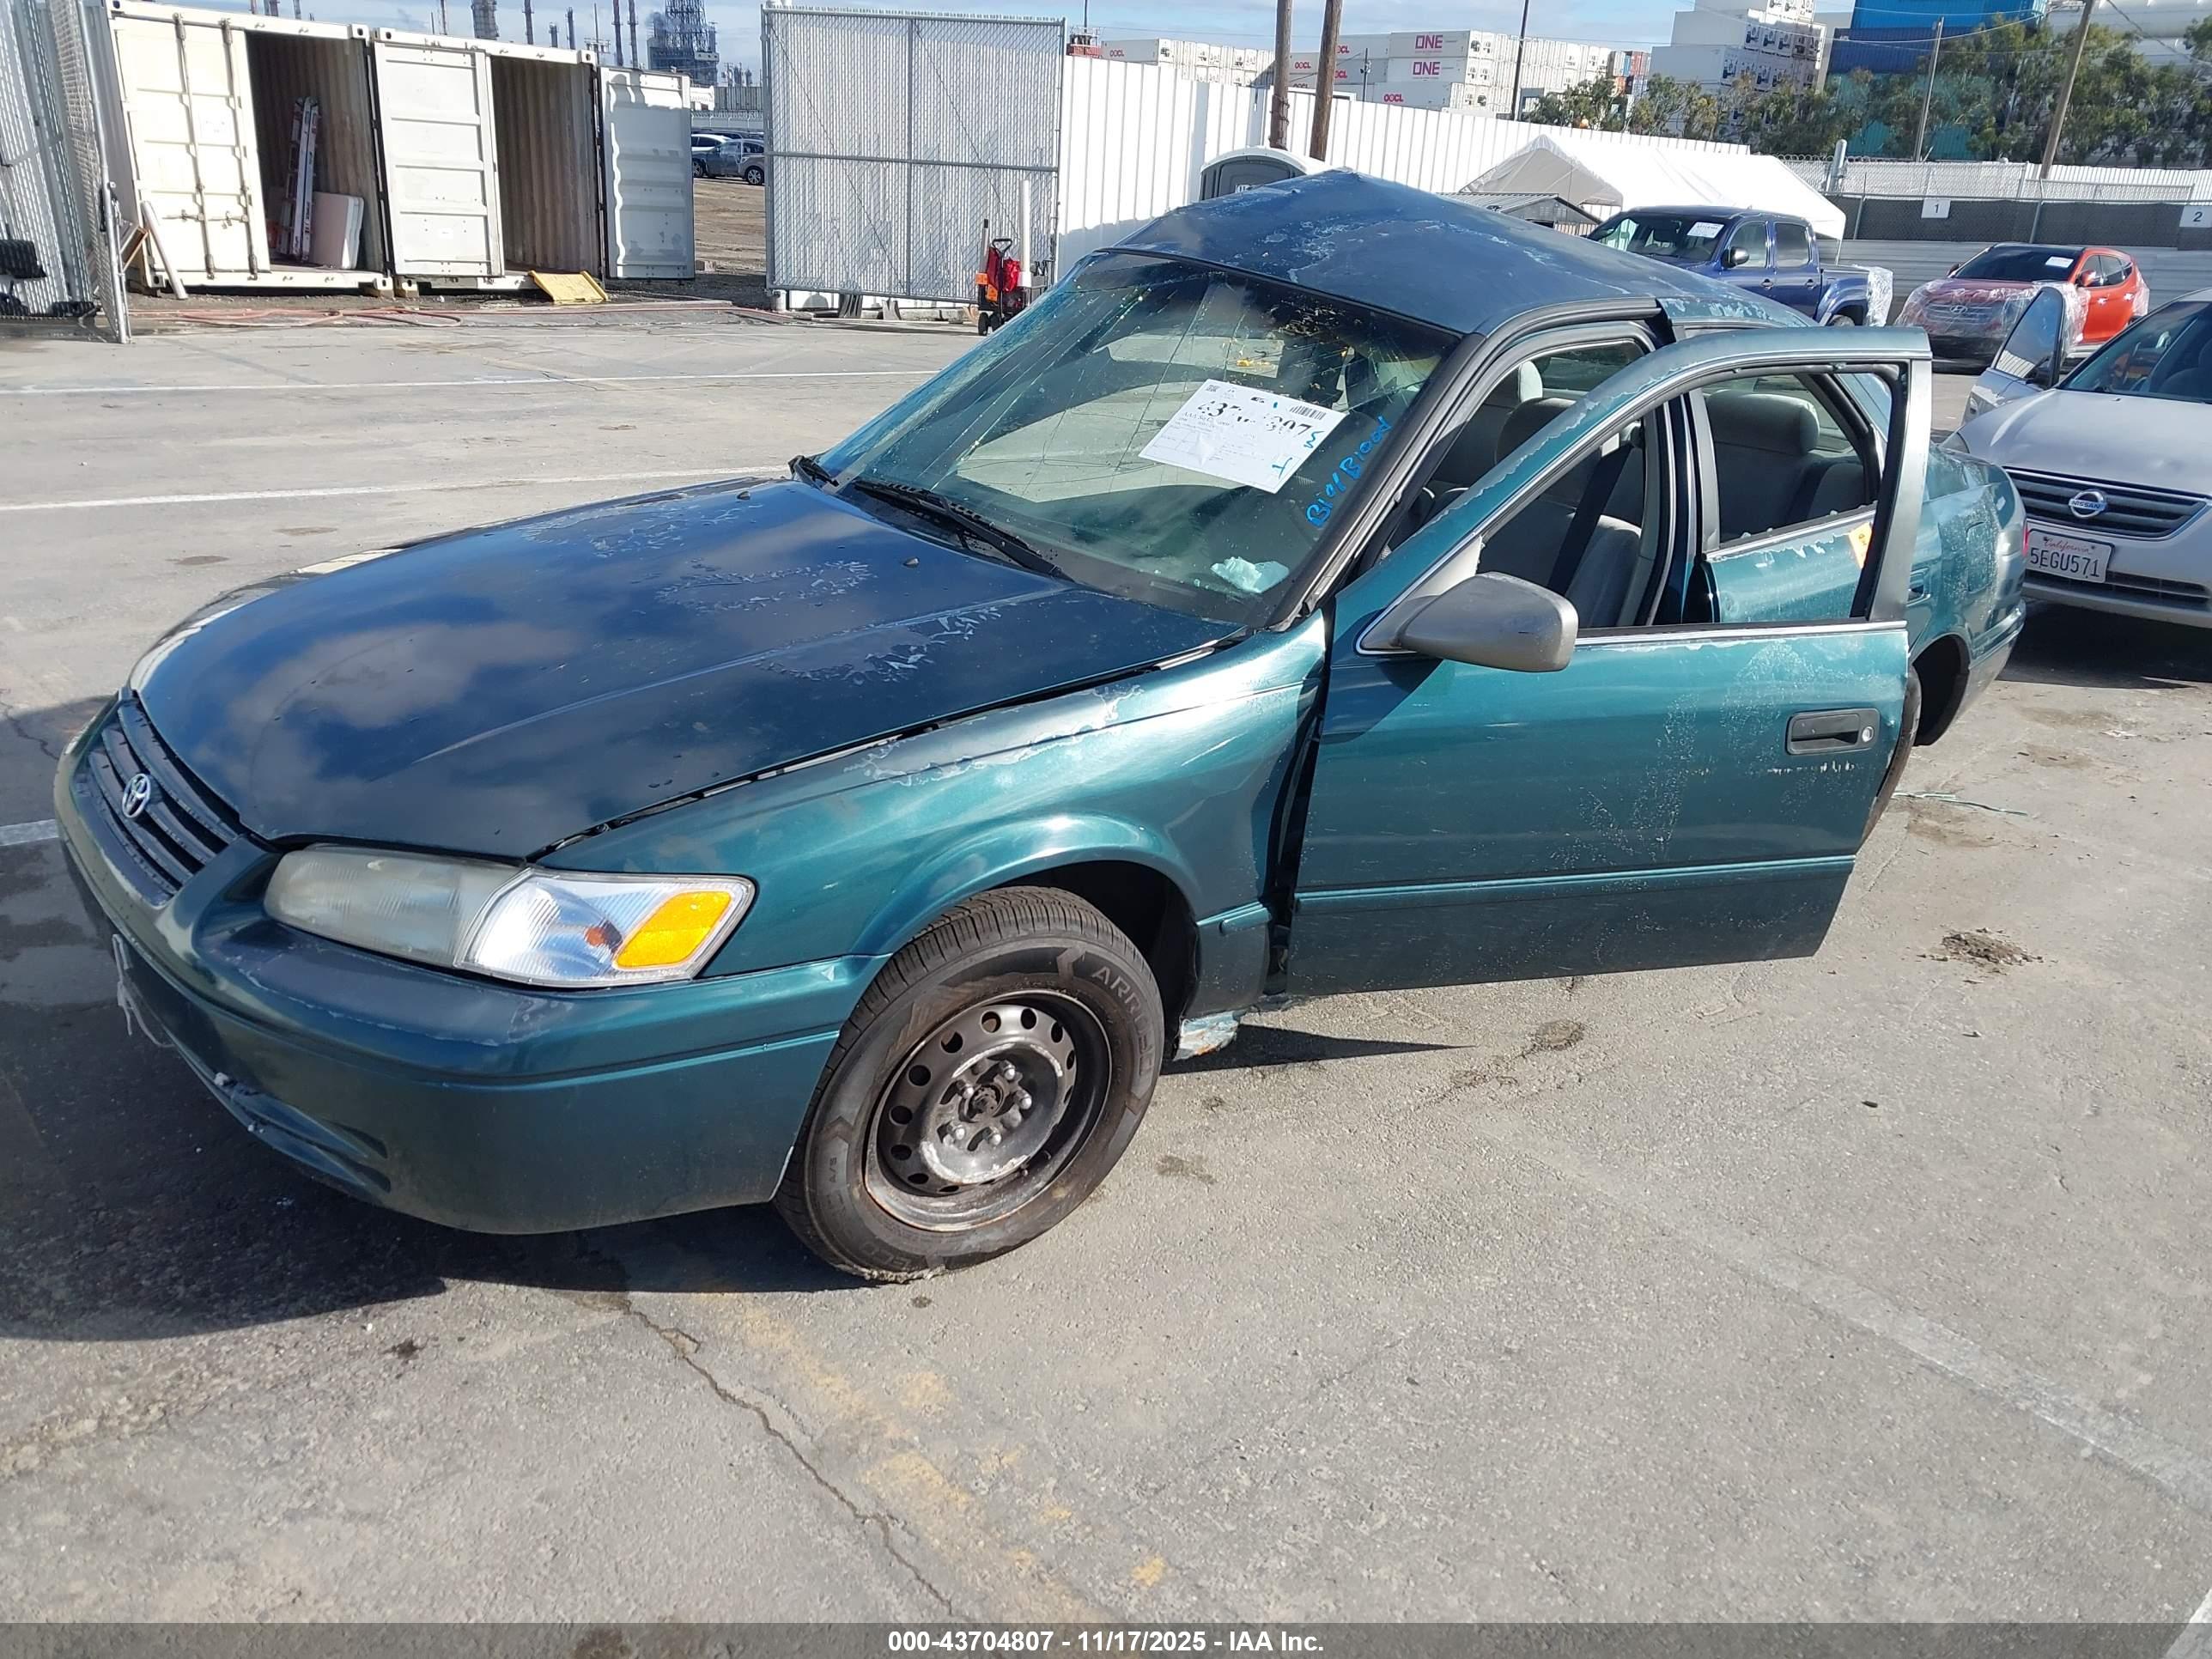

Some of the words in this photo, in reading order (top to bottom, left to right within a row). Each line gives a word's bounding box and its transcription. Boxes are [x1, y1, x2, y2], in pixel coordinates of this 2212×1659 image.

[1415, 34, 1443, 49] ONE
[1413, 61, 1441, 76] ONE
[1383, 94, 1403, 102] OOCL
[1933, 204, 1940, 214] 1
[2192, 211, 2203, 222] 2
[2070, 500, 2101, 510] NISSAN
[2045, 538, 2090, 553] California
[2029, 547, 2100, 578] 5EGU571
